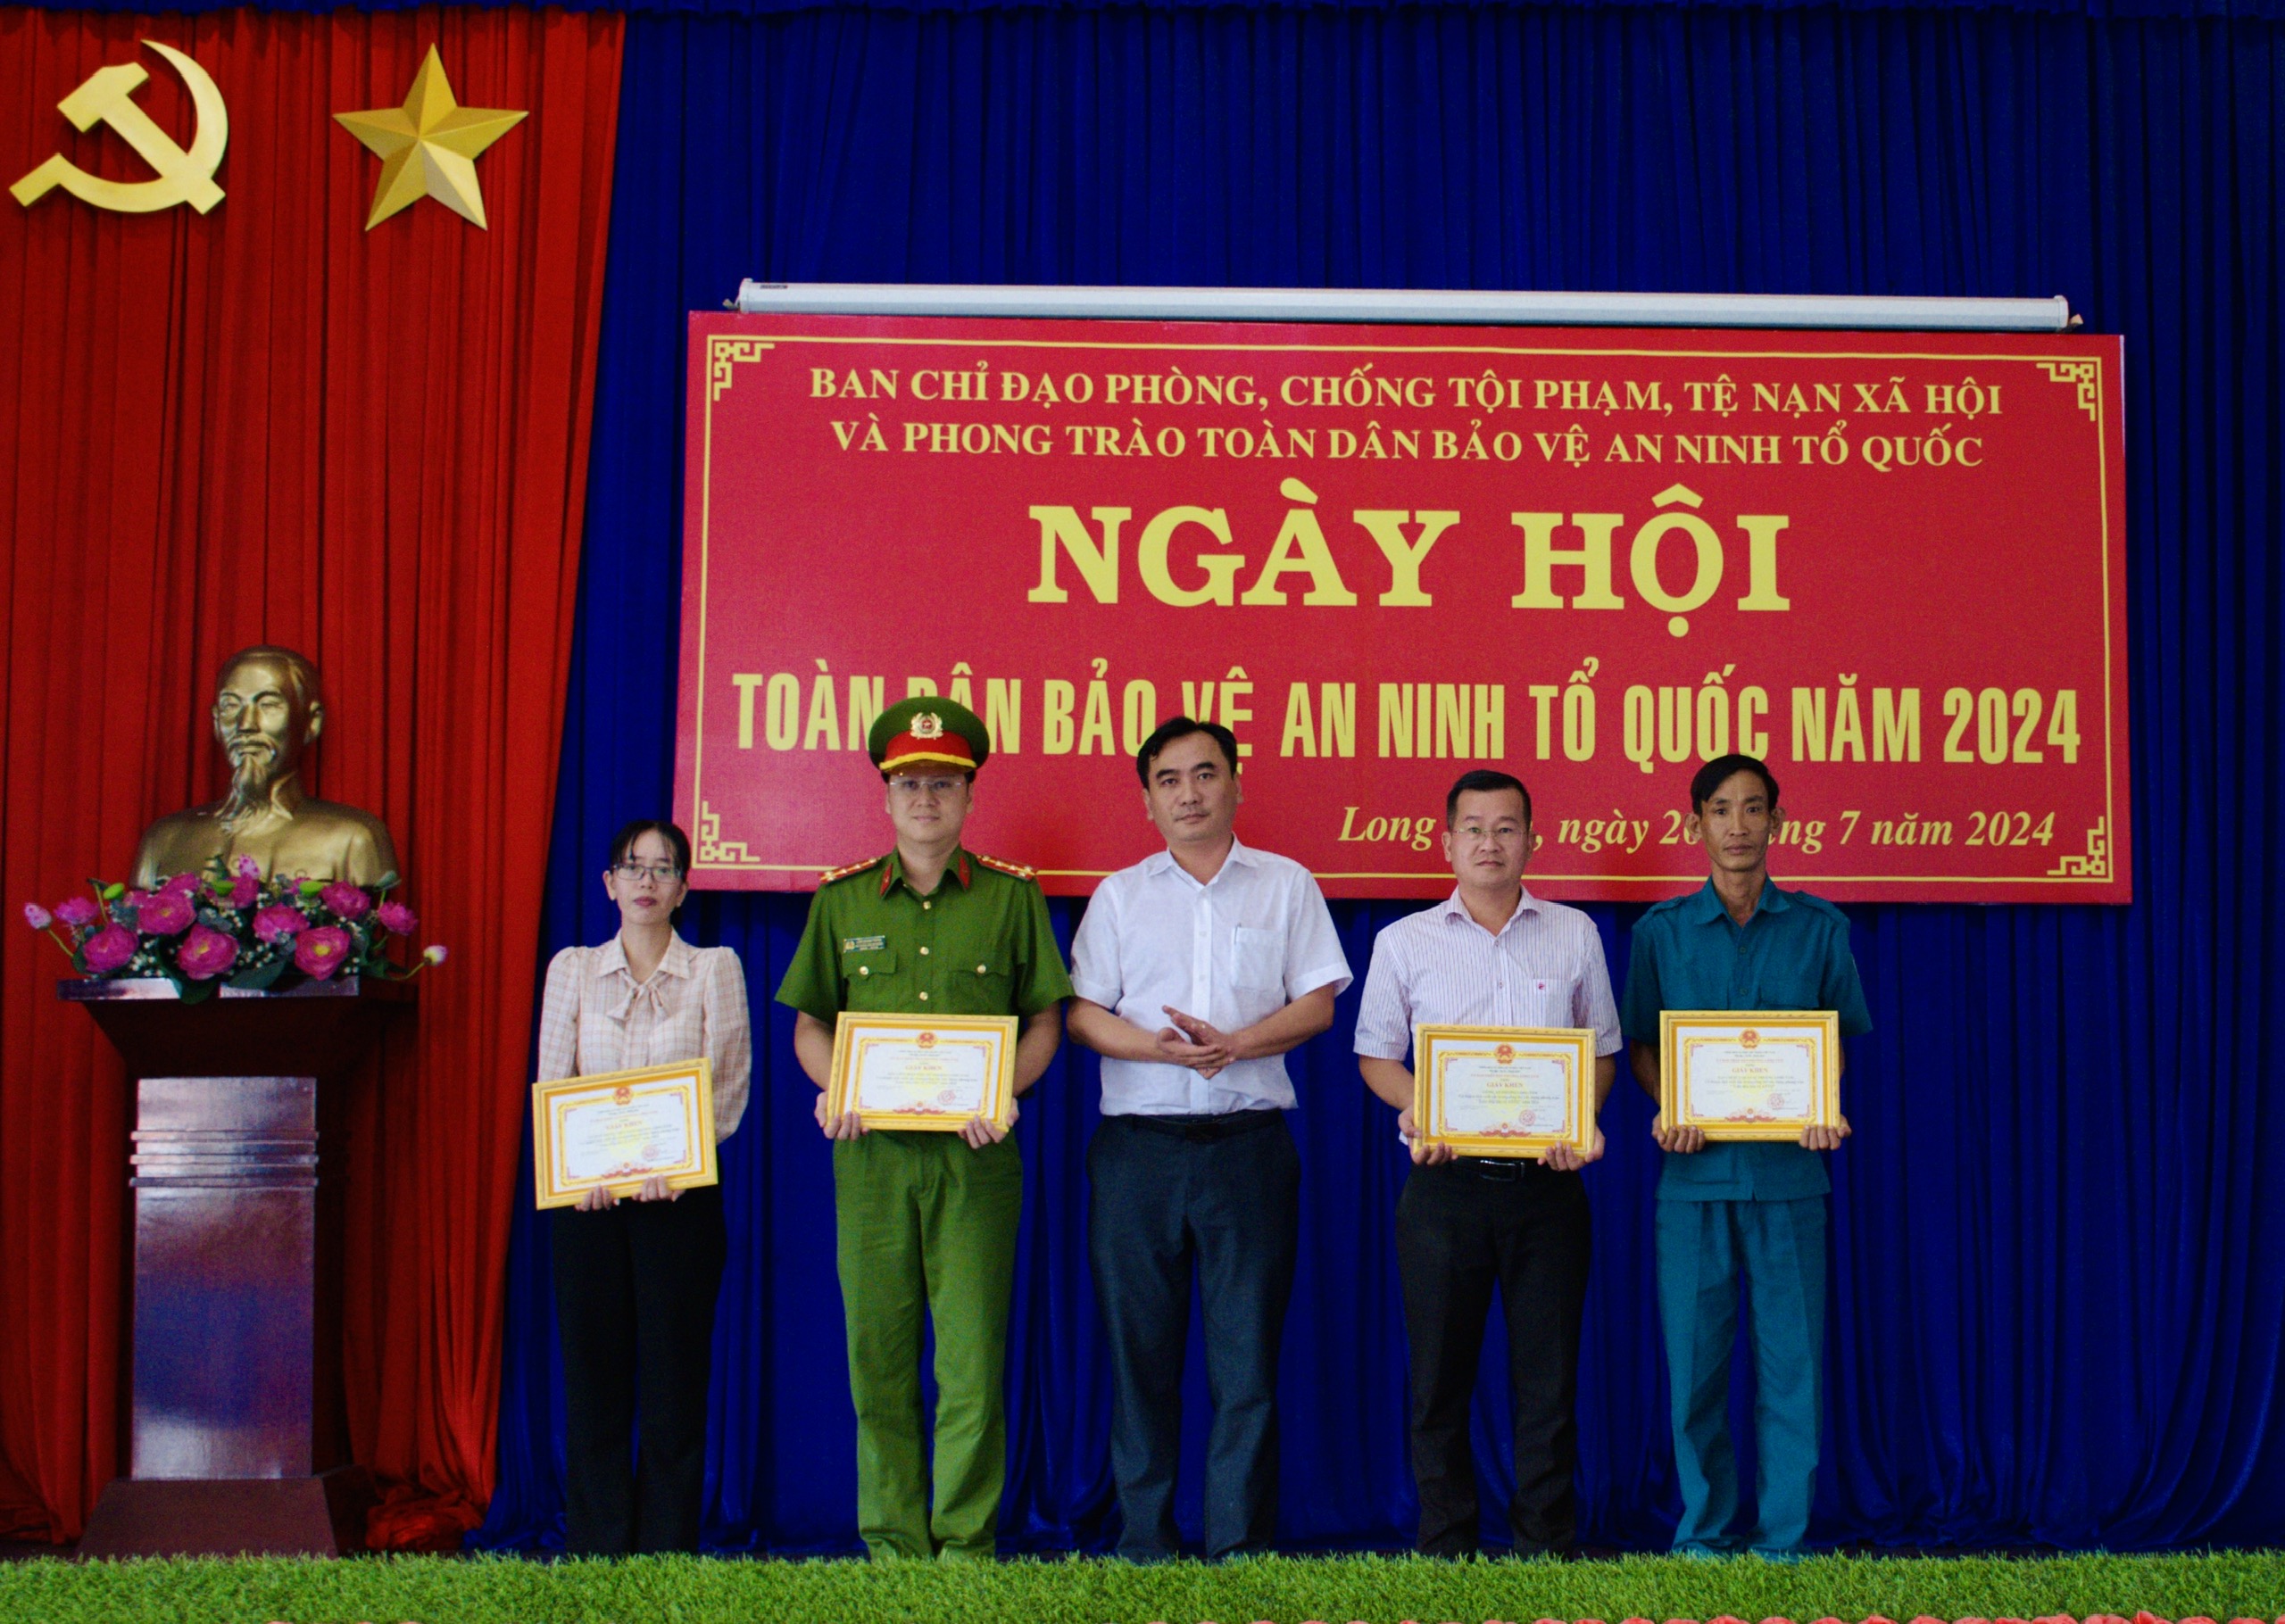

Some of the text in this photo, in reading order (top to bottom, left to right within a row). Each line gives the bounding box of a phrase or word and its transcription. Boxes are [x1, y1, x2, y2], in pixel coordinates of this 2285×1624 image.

[810, 360, 2005, 420] BAN CHỈ ĐẠO PHÒNG, CHỐNG TỘI PHẠM, TỆ NẠN XÃ HỘI
[831, 412, 1982, 472] VÀ PHONG TRÀO TOÀN DÂN BẢO VỆ AN NINH TỔ QUỐC
[1027, 476, 1791, 638] NGÀY HỘI
[732, 658, 885, 752] TOÀN
[1043, 657, 1157, 758] BẢO
[1279, 682, 1357, 758] AN
[1378, 683, 1505, 760] NINH
[1528, 656, 1600, 762] TỔ
[1623, 663, 1769, 775] QUỐC
[1791, 673, 1921, 764] NĂM
[1942, 686, 2081, 765] 2024
[1338, 807, 1437, 851] Long
[1558, 808, 1649, 854] ngày
[1840, 810, 1861, 845] 7
[1871, 812, 1952, 846] năm
[1965, 811, 2055, 846] 2024
